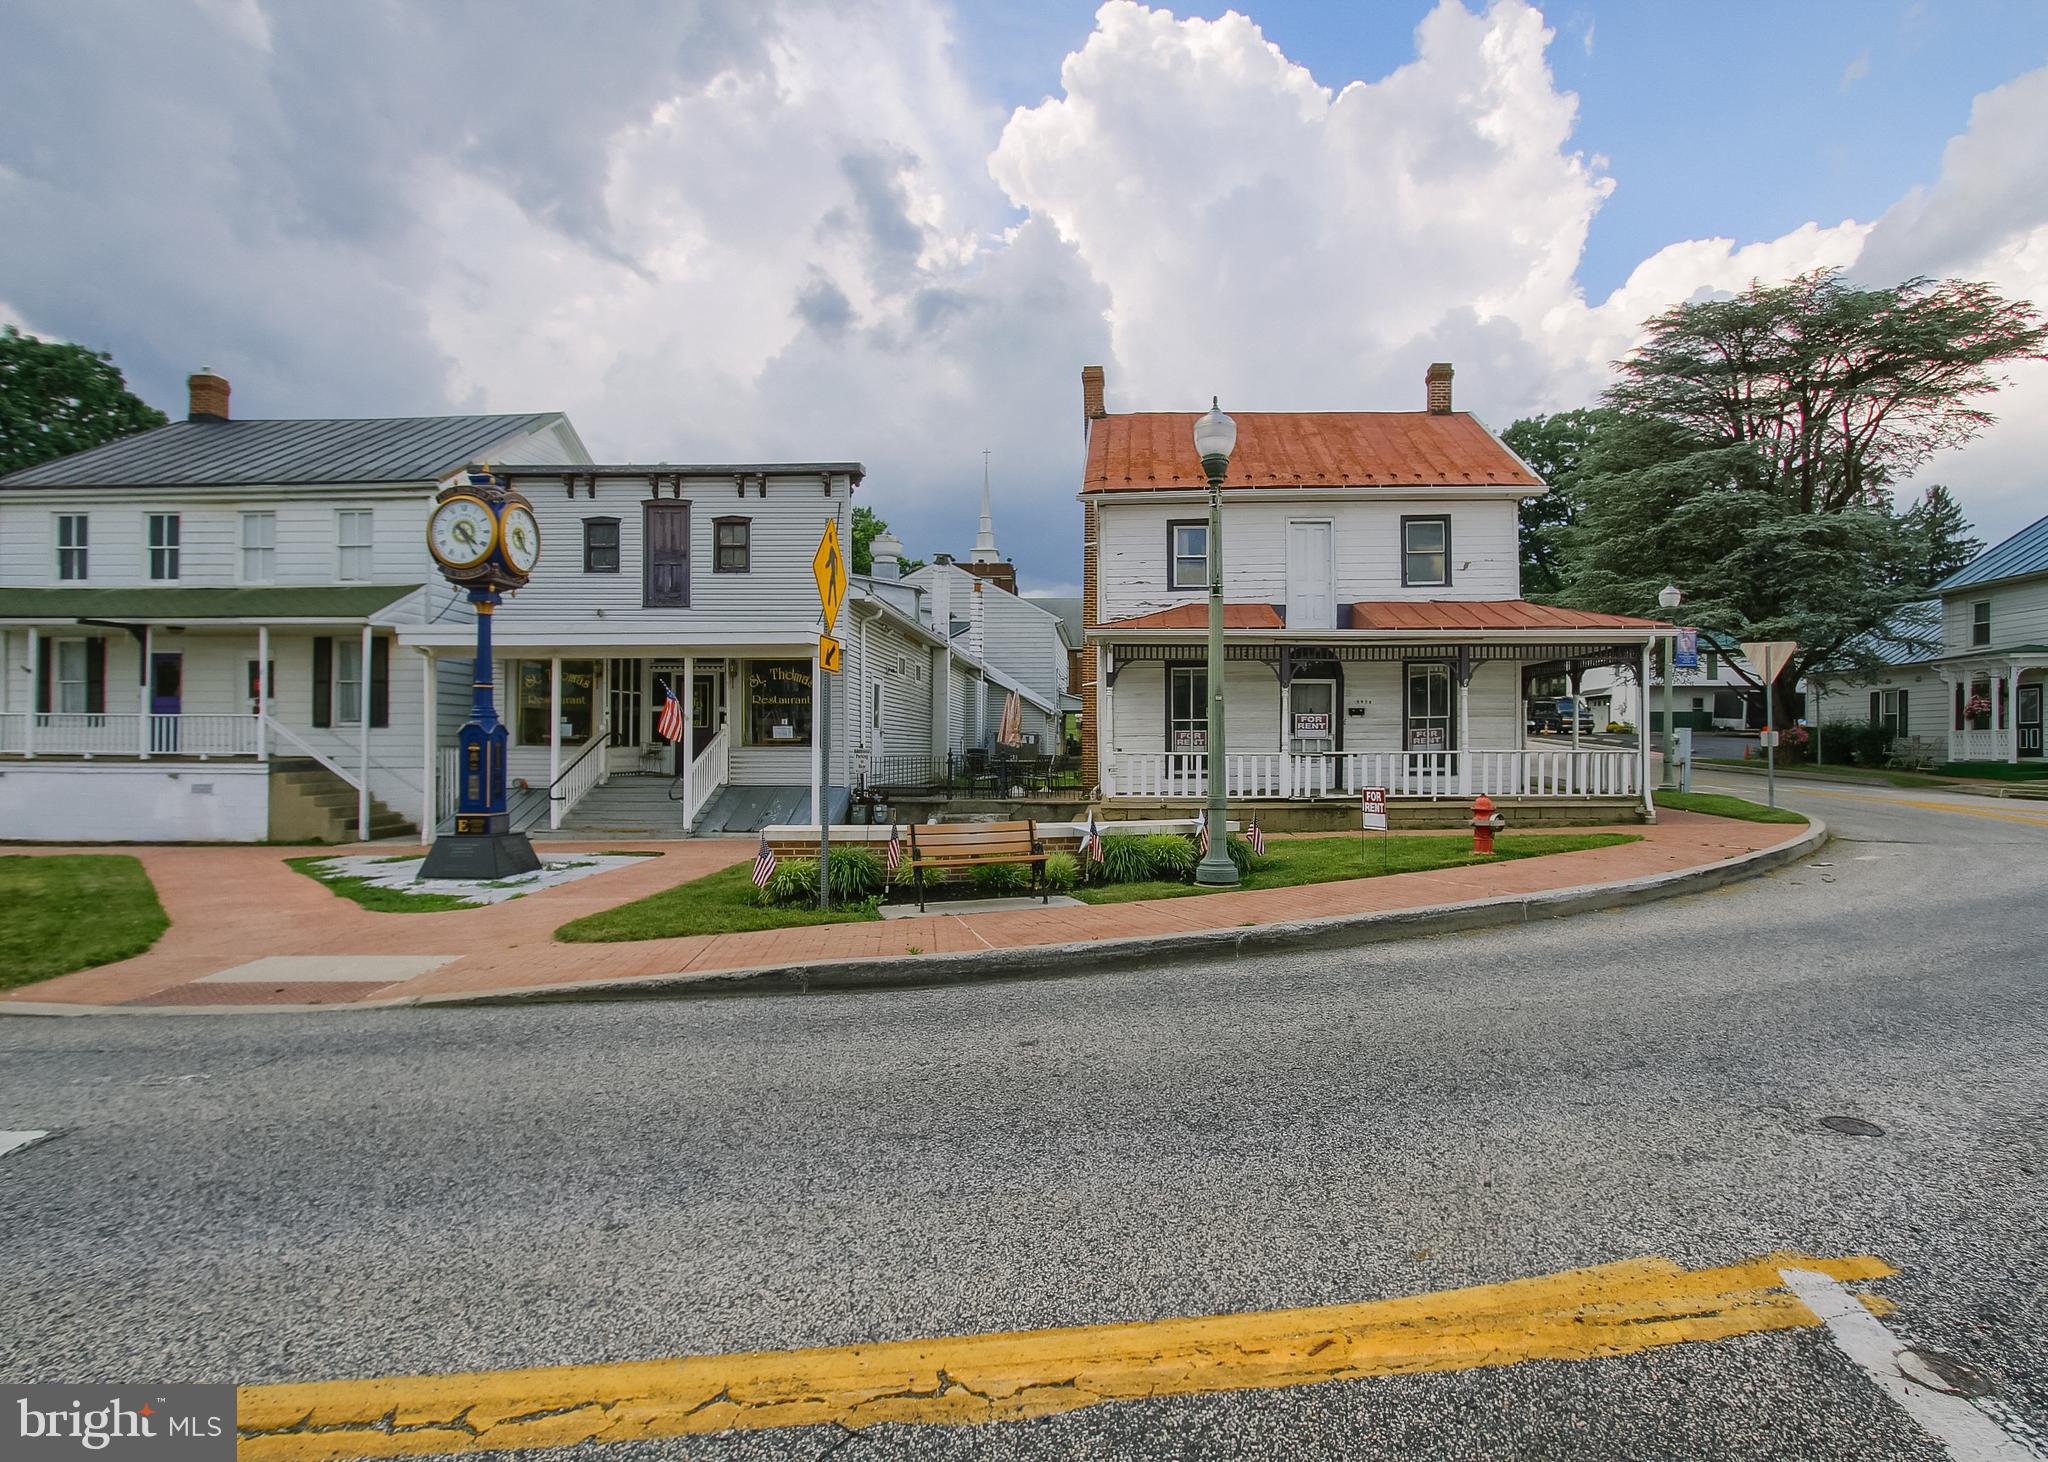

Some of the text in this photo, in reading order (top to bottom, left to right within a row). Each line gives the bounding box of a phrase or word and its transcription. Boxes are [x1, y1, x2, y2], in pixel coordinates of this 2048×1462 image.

[752, 694, 812, 705] Restaurant
[1366, 791, 1382, 802] FOR
[1364, 802, 1385, 813] RENT
